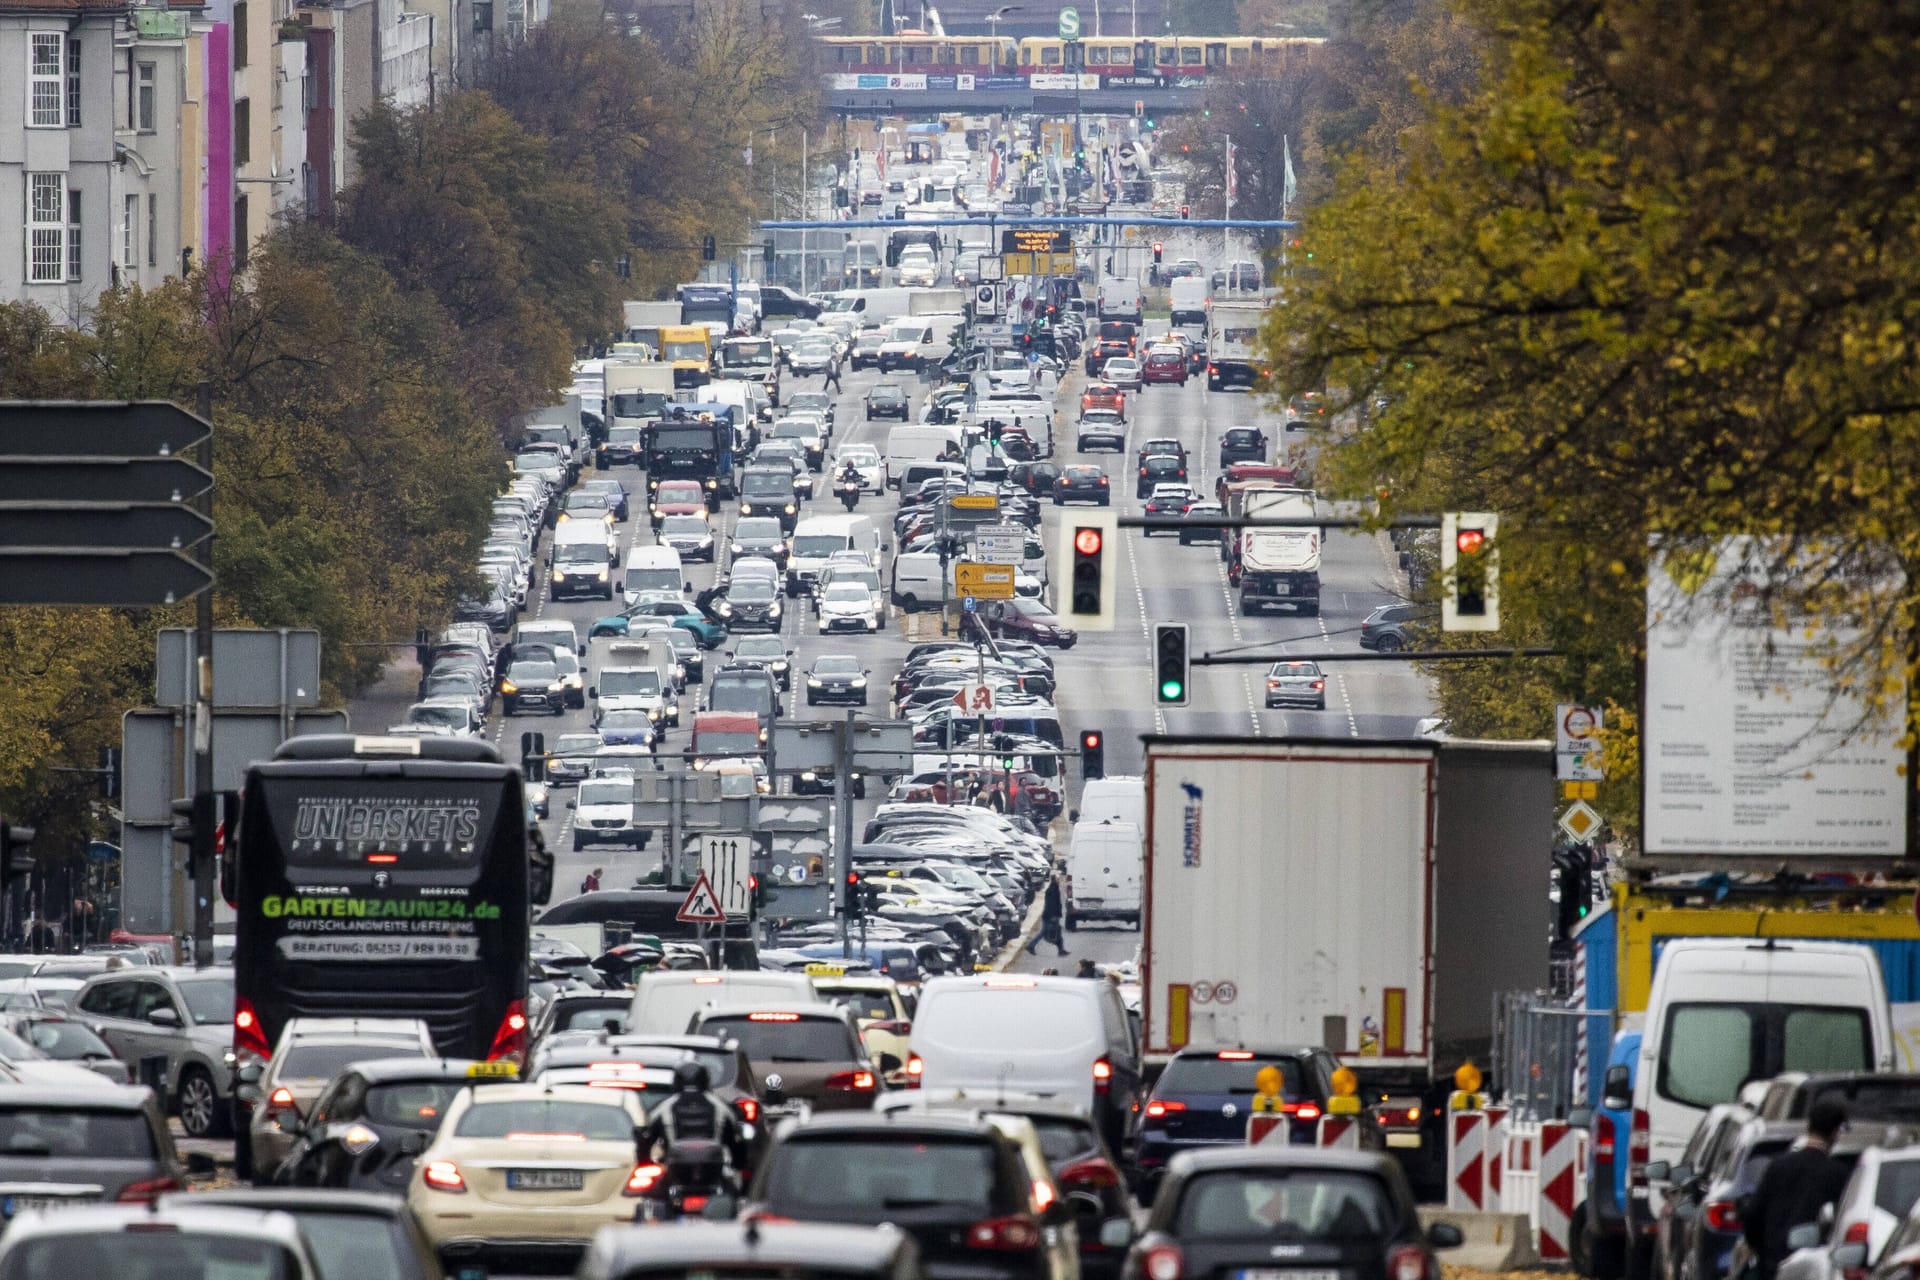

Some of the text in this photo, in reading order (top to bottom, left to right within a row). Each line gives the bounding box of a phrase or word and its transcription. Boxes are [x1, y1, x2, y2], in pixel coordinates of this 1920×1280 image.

[1060, 10, 1077, 34] S
[965, 597, 973, 609] P
[1568, 741, 1593, 750] ZONE
[294, 805, 481, 841] UNI BASKETS
[262, 896, 500, 918] GARTENZAUN24.de
[288, 919, 474, 933] DEUTSCHLANDWEITE LIEFERUNG
[292, 942, 363, 954] BERATUNG:
